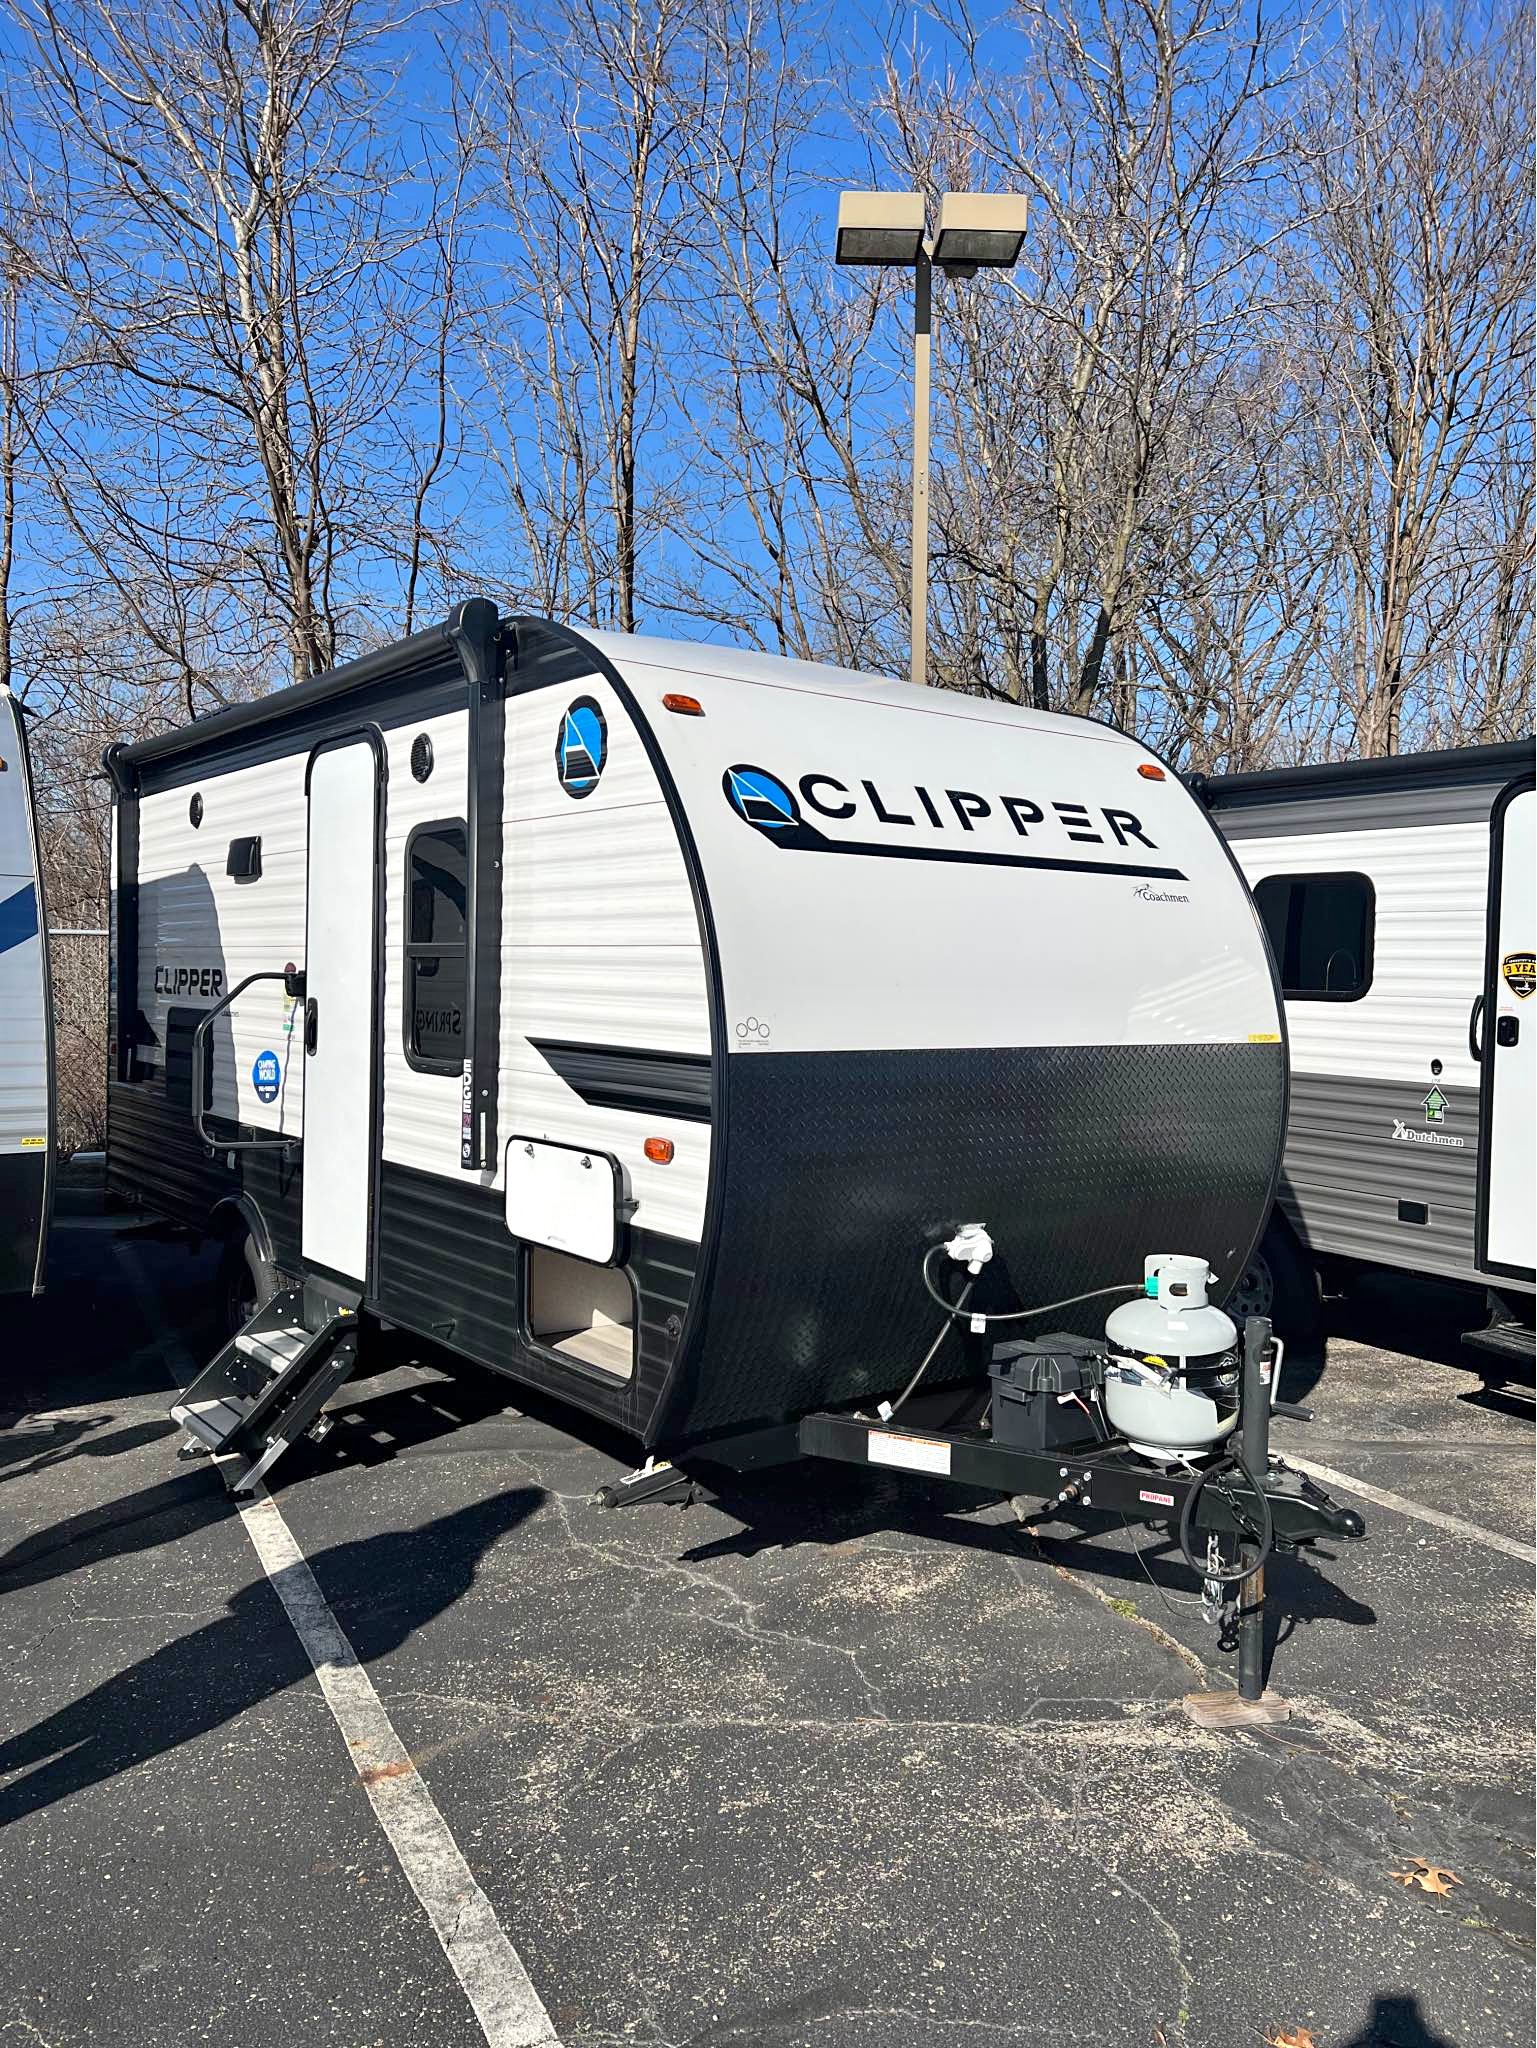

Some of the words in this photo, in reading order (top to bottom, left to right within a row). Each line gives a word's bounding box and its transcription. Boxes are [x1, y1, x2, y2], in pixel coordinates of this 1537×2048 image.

[799, 773, 1160, 849] CLIPPER
[1143, 891, 1190, 902] Coachmen
[1506, 965, 1512, 974] 3
[154, 966, 223, 997] CLIPPER
[1406, 1130, 1463, 1146] Dutchmen
[1142, 1492, 1172, 1504] PROPANE
